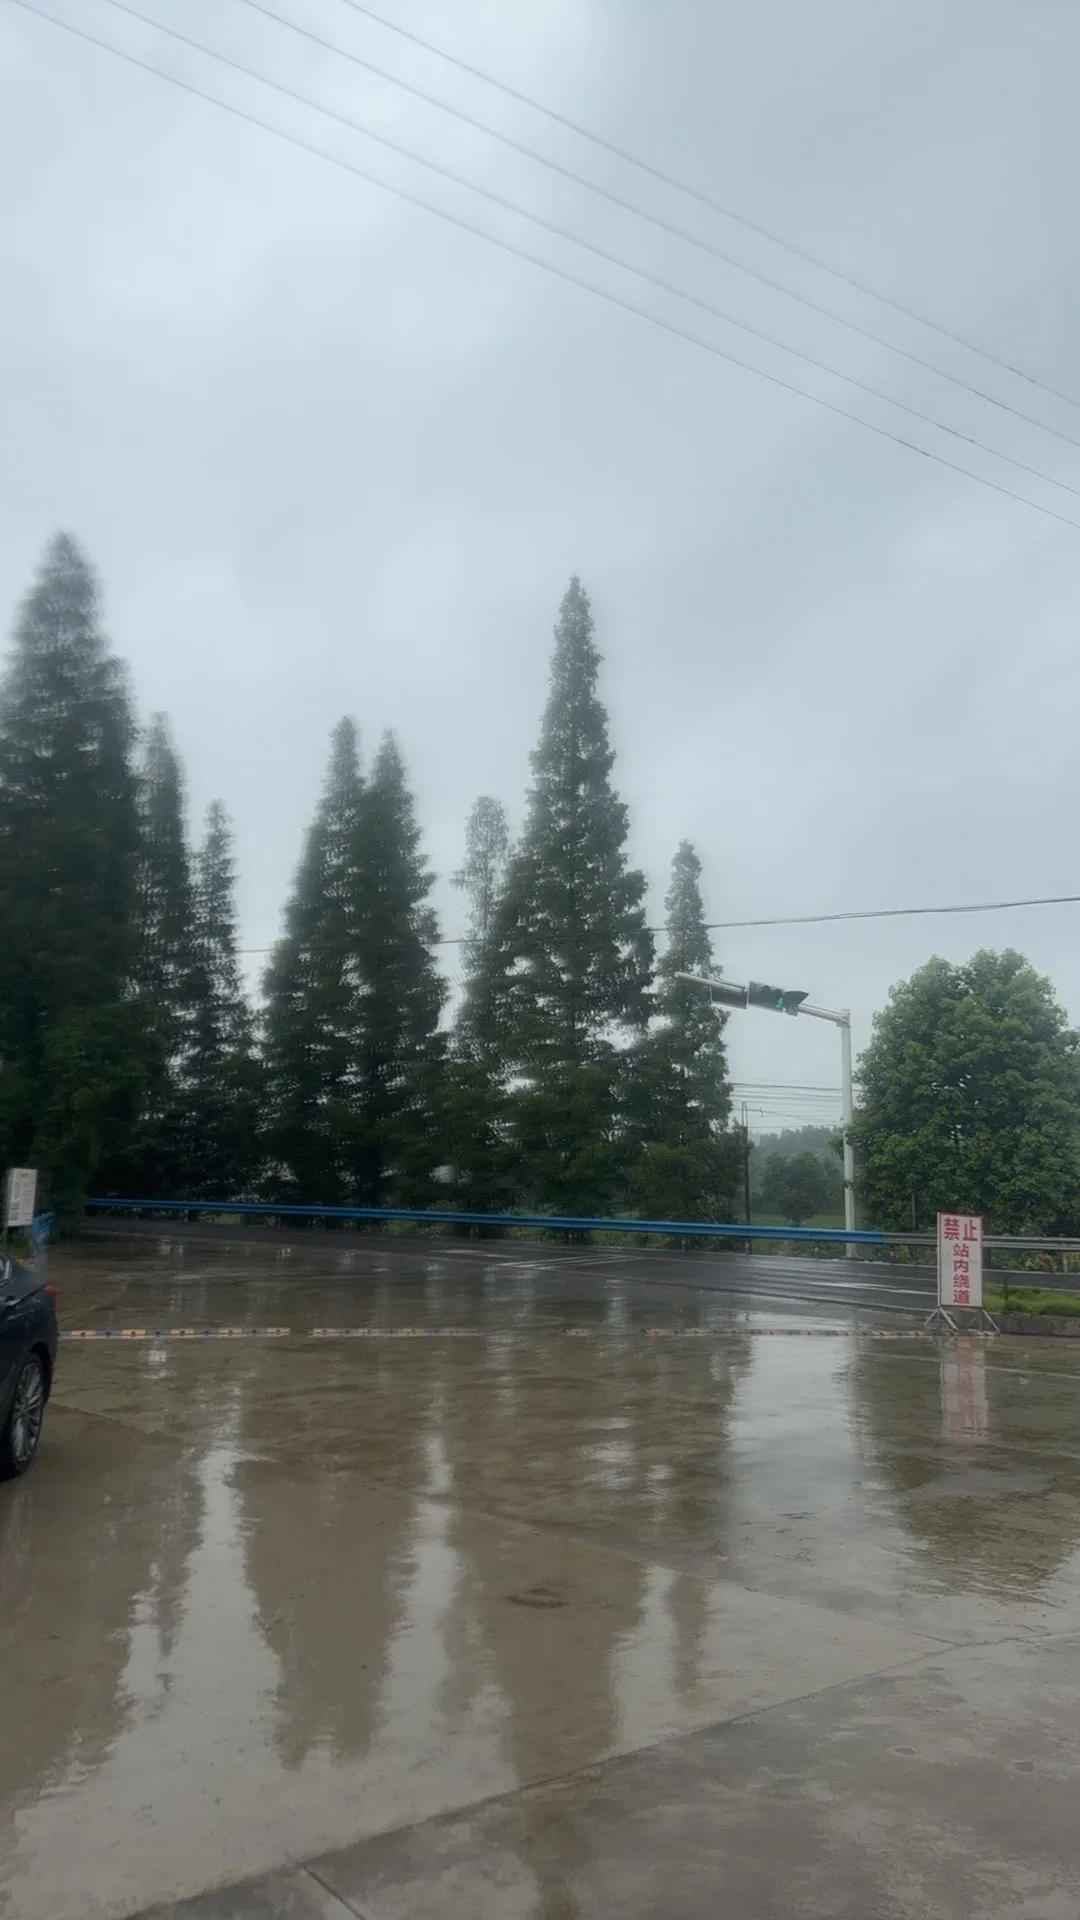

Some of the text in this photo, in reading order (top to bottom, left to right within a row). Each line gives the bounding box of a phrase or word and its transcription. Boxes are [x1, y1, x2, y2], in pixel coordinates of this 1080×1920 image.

[944, 1217, 977, 1241] 禁止
[953, 1243, 970, 1304] 站内绕道
